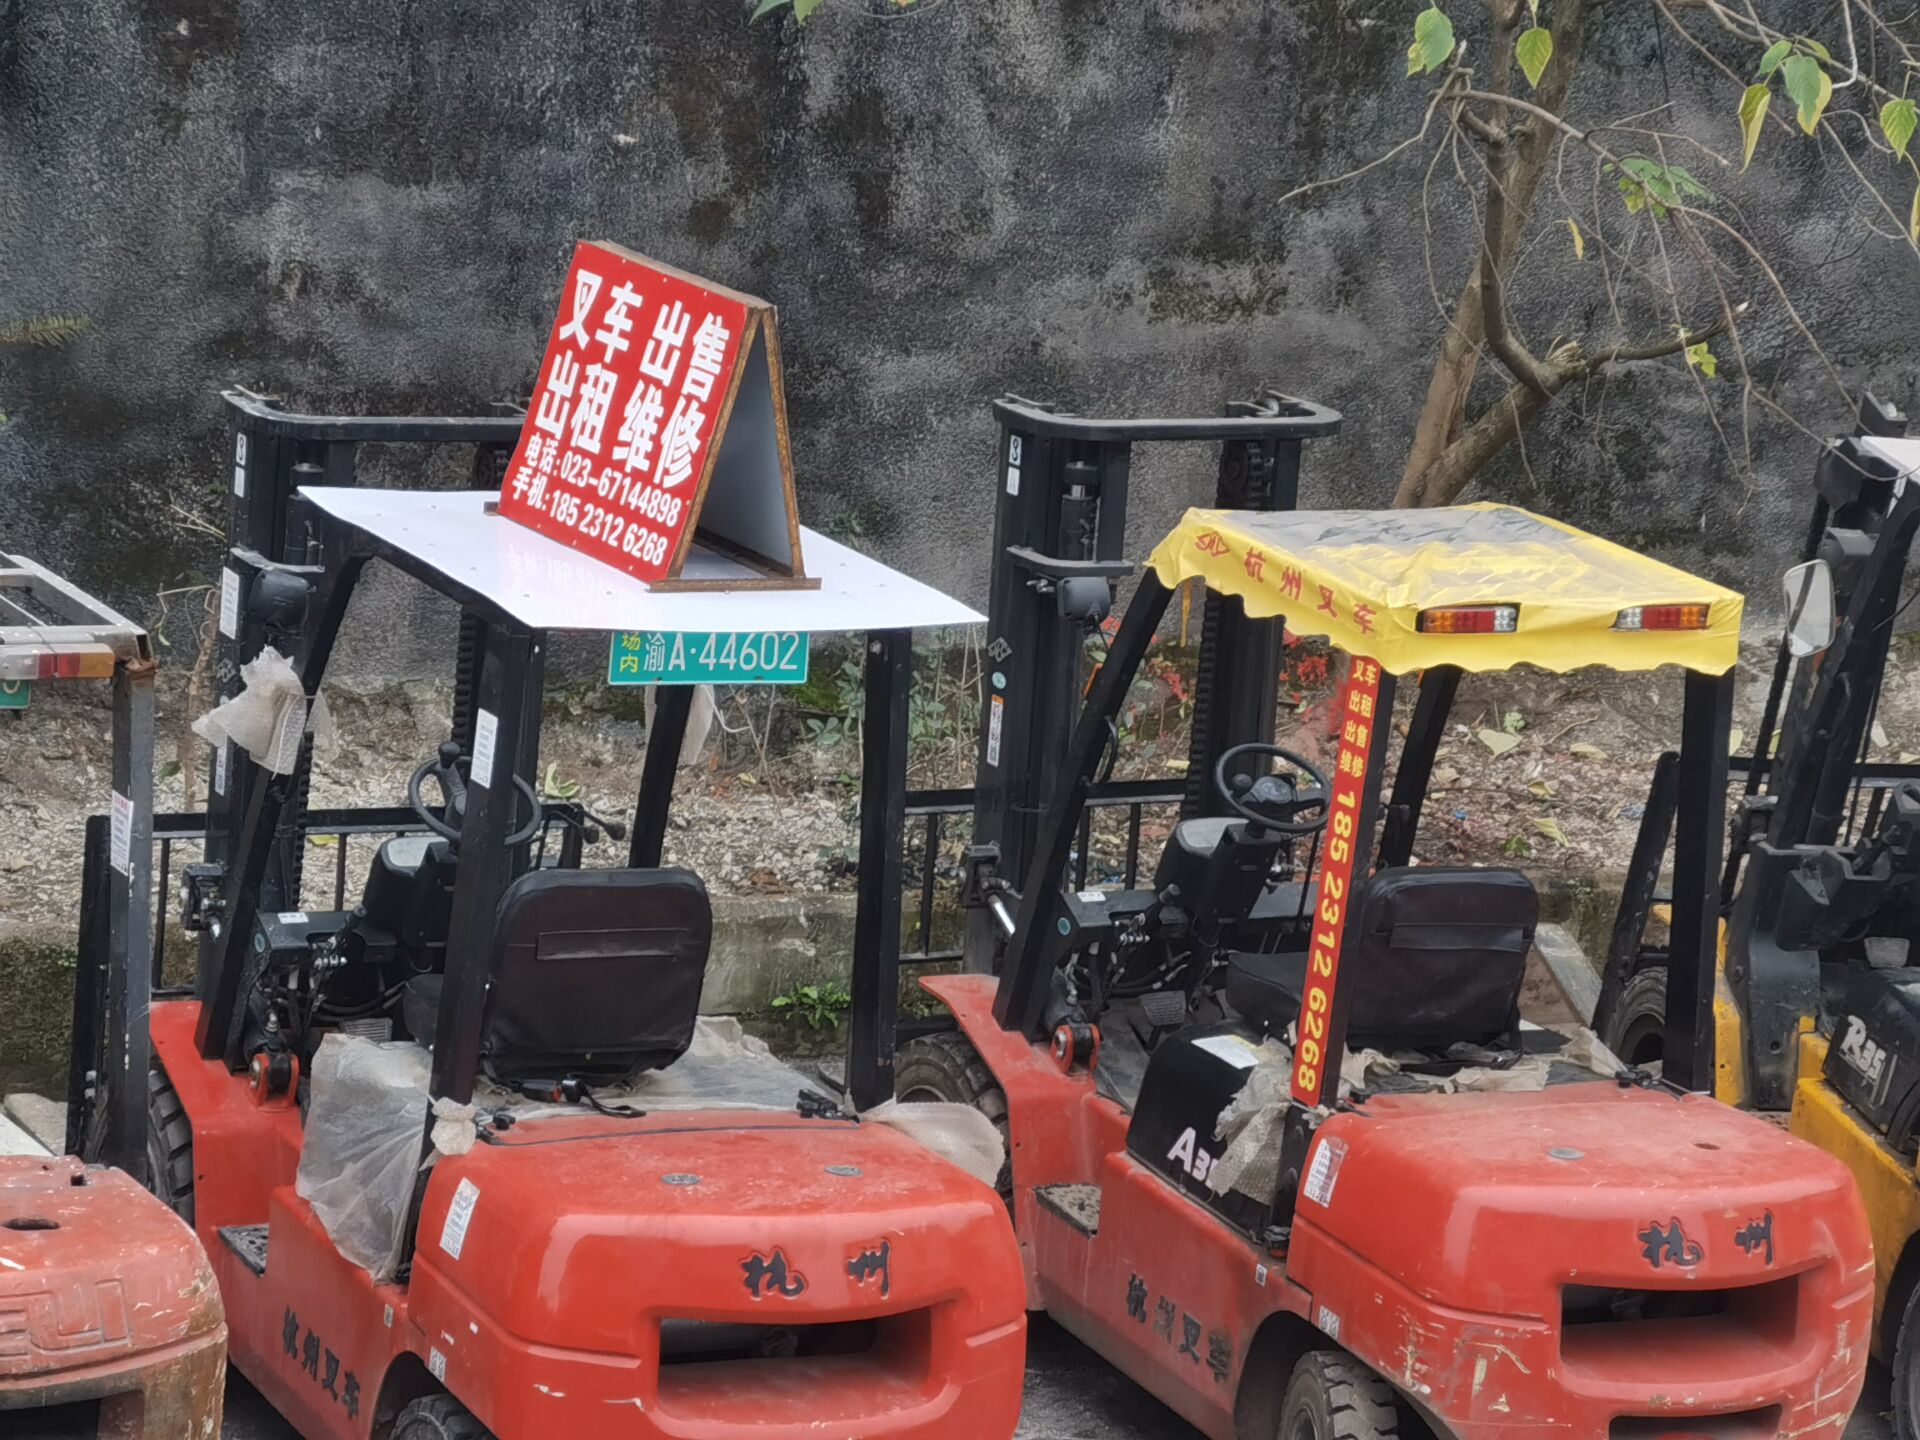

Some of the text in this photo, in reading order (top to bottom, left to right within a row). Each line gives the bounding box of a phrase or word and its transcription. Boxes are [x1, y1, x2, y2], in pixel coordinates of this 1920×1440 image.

[559, 268, 730, 402] 叉车 出售
[535, 349, 706, 488] 出租 维修
[578, 503, 624, 547] 2312
[622, 523, 668, 566] 6268
[1244, 547, 1376, 634] 杭州叉车
[620, 632, 640, 673] 场内
[1352, 659, 1377, 687] 叉车
[1344, 720, 1368, 748] 出售
[1348, 689, 1373, 718] 出租
[1339, 749, 1364, 778] 维修
[1298, 790, 1356, 1092] 185 2312 6268
[1166, 1127, 1219, 1190] A3
